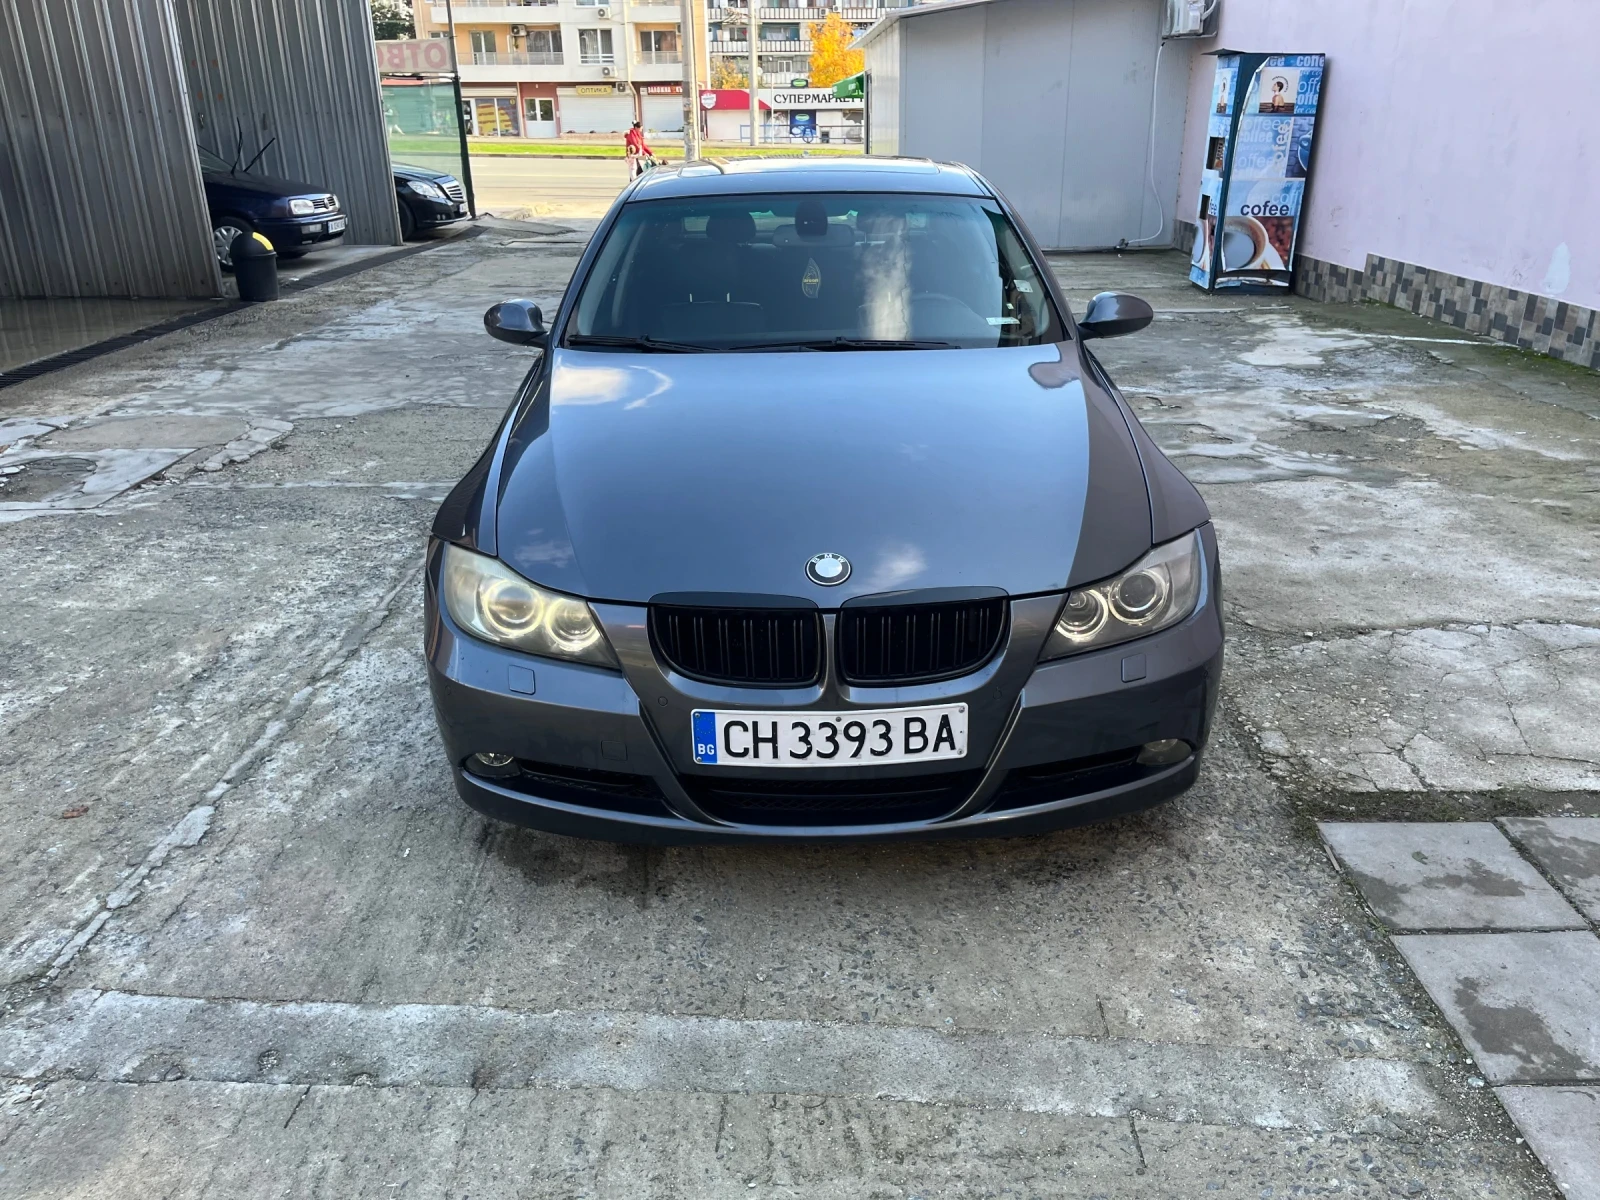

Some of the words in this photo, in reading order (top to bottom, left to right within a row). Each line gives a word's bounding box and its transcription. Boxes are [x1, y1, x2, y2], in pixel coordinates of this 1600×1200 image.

[1240, 201, 1290, 216] cofee
[723, 720, 779, 759] CH
[789, 719, 894, 759] 3393
[904, 713, 957, 755] BA
[697, 743, 715, 755] BG
